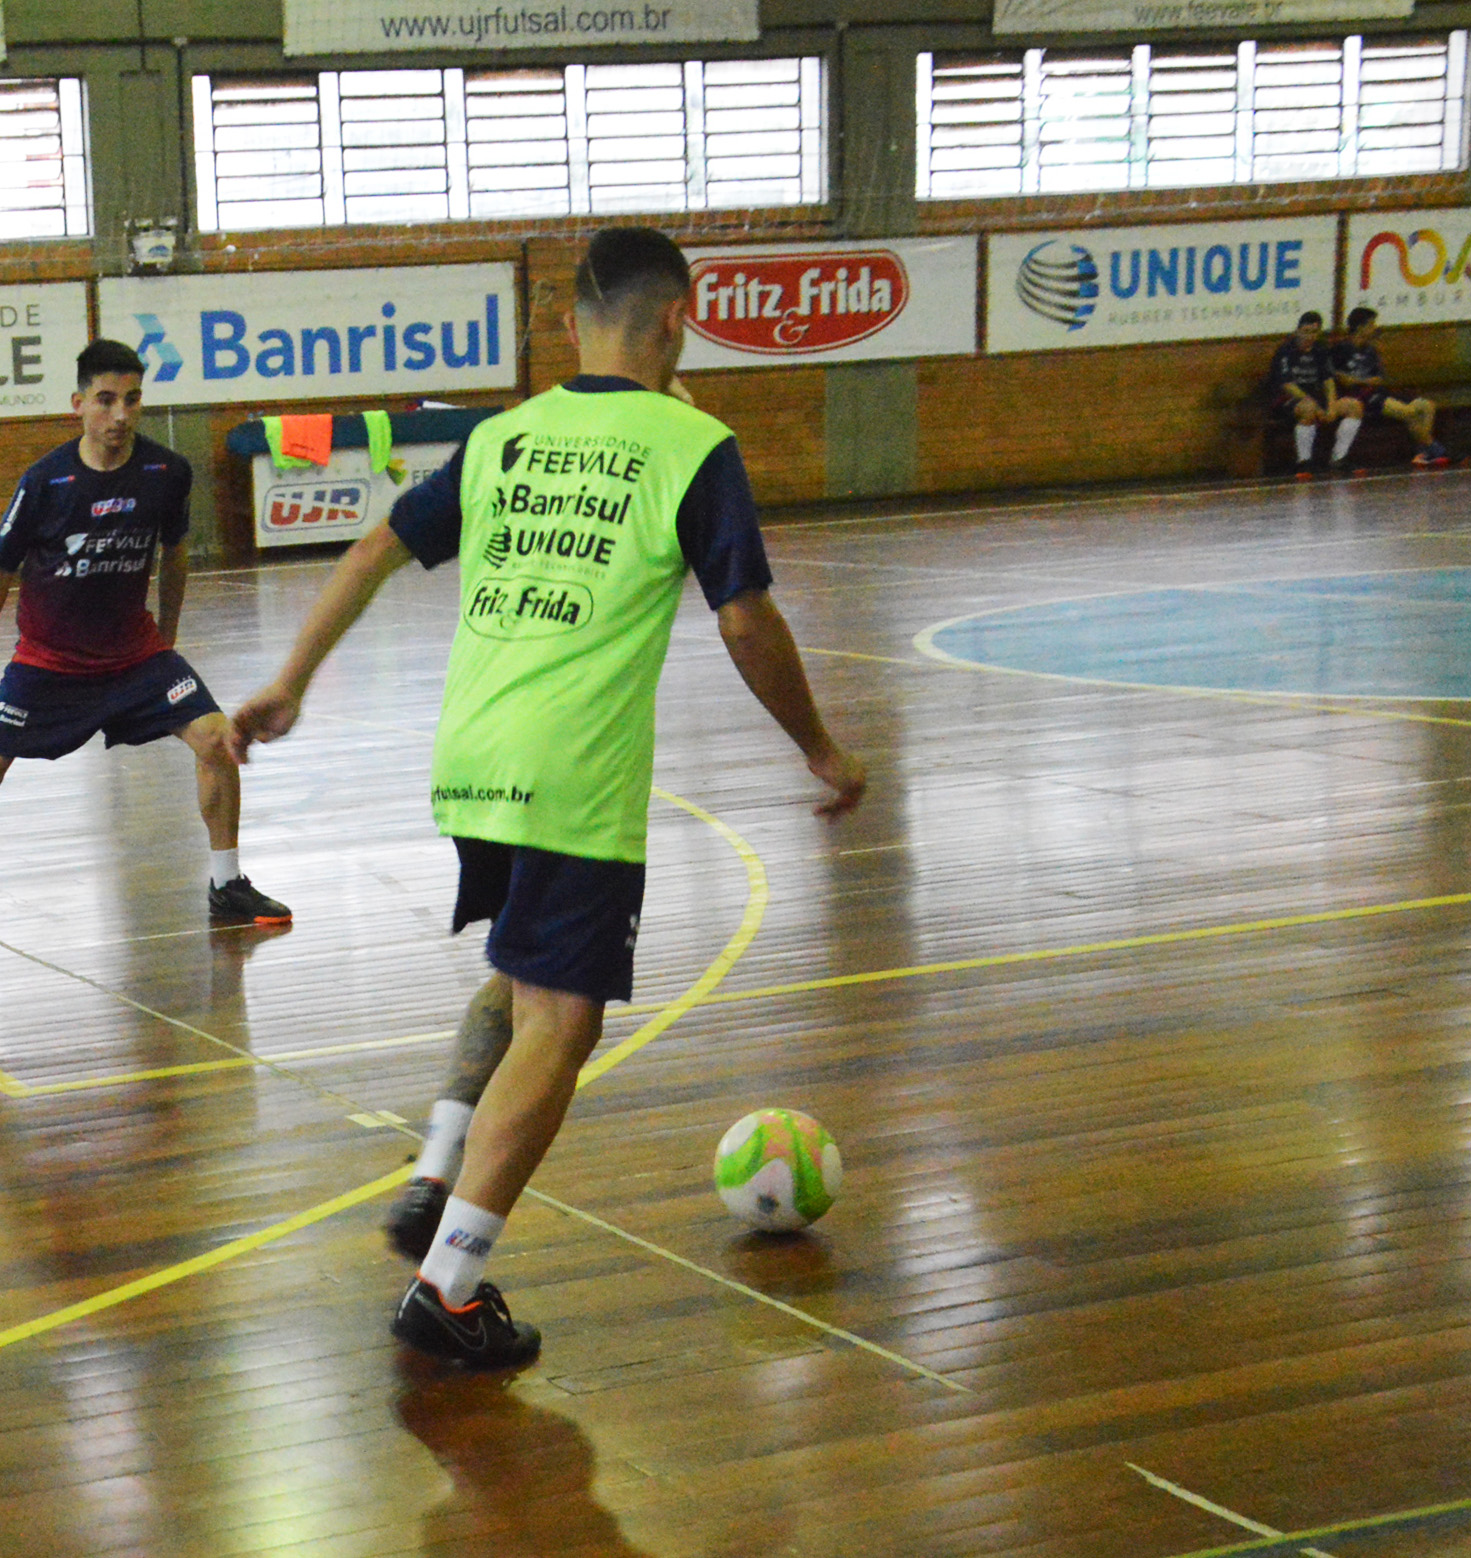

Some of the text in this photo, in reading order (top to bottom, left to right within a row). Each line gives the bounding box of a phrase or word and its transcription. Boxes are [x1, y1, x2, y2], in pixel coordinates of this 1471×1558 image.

[380, 5, 672, 45] www.ujrfutsal.com.br
[1110, 240, 1303, 299] UNIQUE
[696, 267, 891, 321] Fritz Frida
[199, 293, 501, 380] Banrisul
[527, 449, 645, 483] FEEVALE
[270, 487, 362, 527] UJR
[510, 484, 632, 525] Banrisul
[515, 586, 581, 625] Frida
